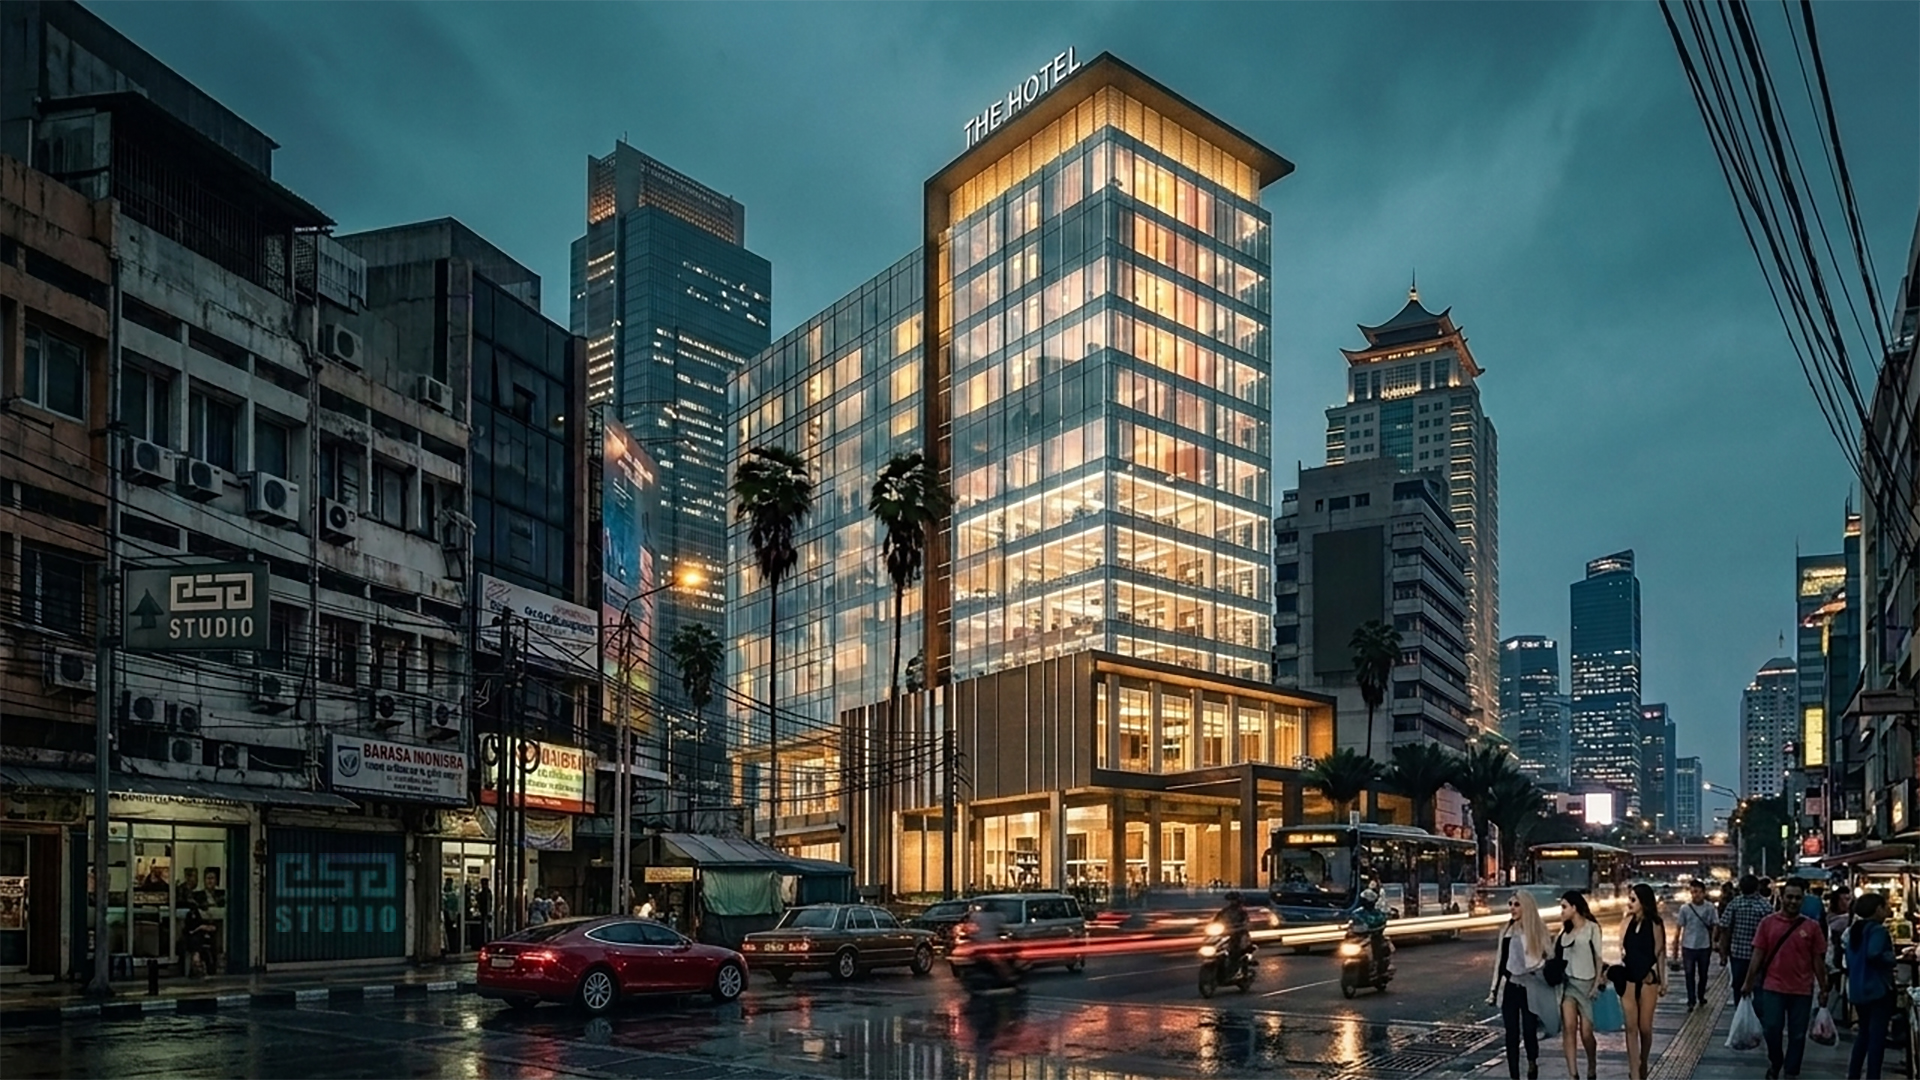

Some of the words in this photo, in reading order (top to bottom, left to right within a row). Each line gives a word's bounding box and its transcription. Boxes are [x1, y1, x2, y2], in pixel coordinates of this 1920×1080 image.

[964, 100, 1003, 149] THE
[1008, 46, 1082, 117] HOTEL
[169, 616, 253, 639] STUDIO
[363, 743, 412, 763] BARASA
[276, 905, 396, 932] STUDIO
